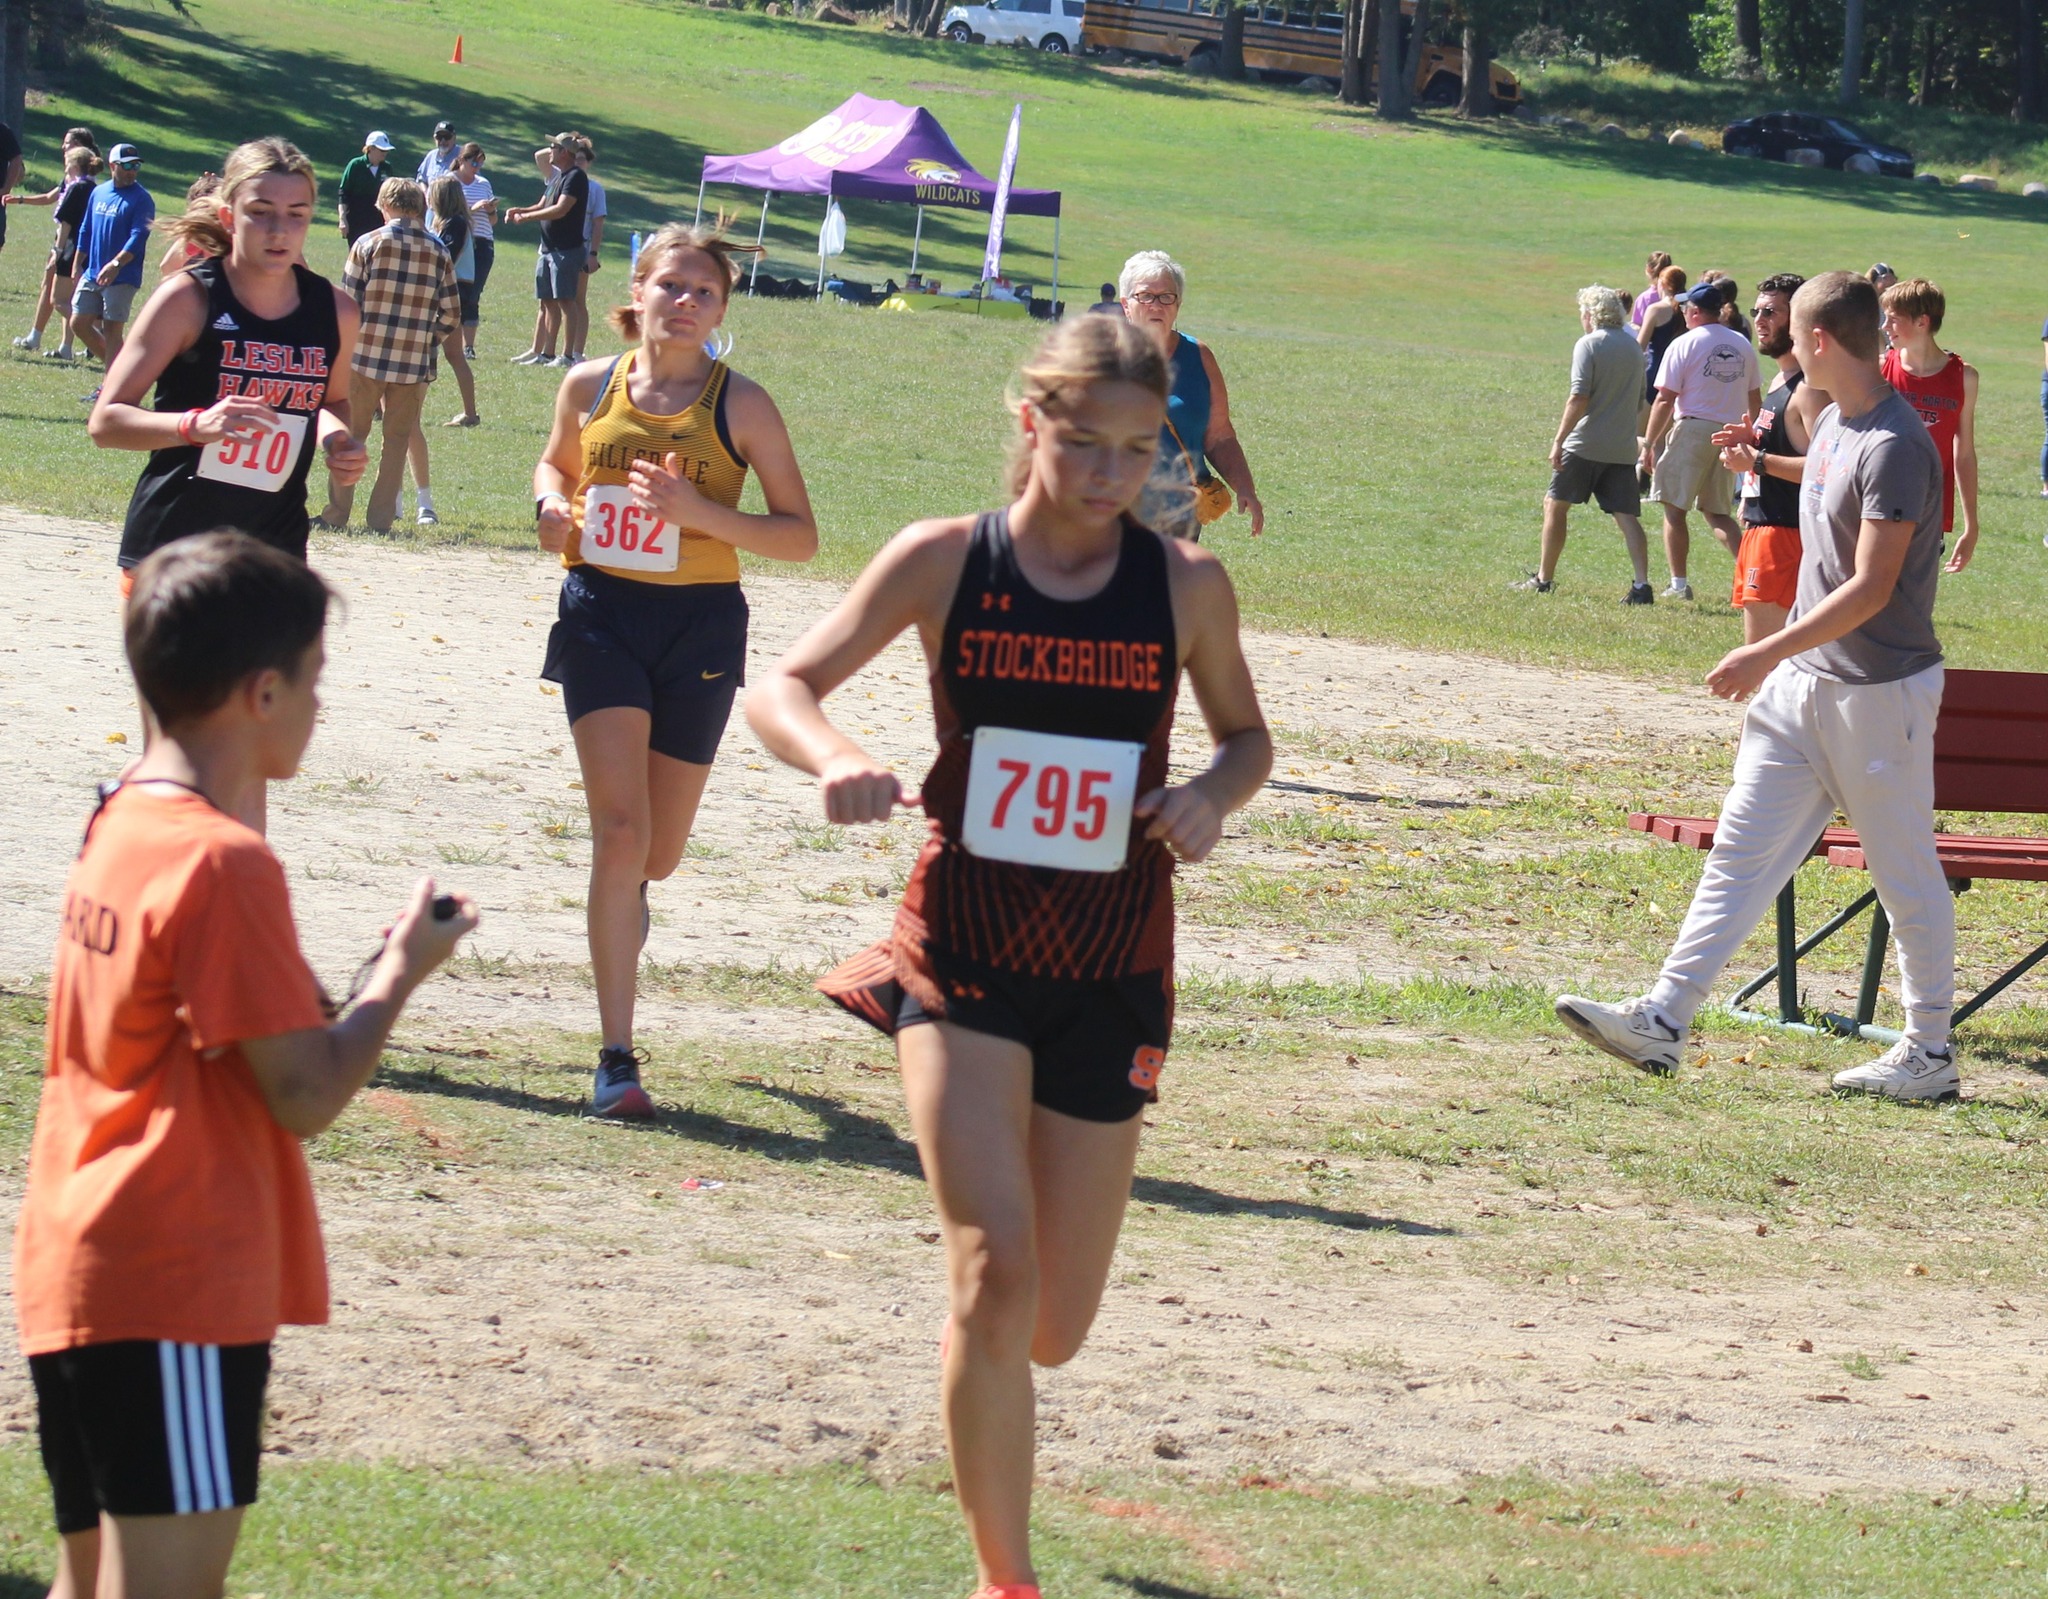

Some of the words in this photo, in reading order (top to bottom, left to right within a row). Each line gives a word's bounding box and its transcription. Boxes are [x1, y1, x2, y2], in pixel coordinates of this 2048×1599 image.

[915, 183, 980, 204] WILDCATS
[220, 340, 328, 377] LESLIE
[217, 373, 325, 410] HAWKS
[218, 425, 290, 474] 510
[589, 441, 710, 485] HILLSDLE
[595, 502, 665, 554] 362
[957, 629, 1163, 691] STOCKBRIDGE
[990, 758, 1112, 842] 795
[1128, 1045, 1165, 1090] S
